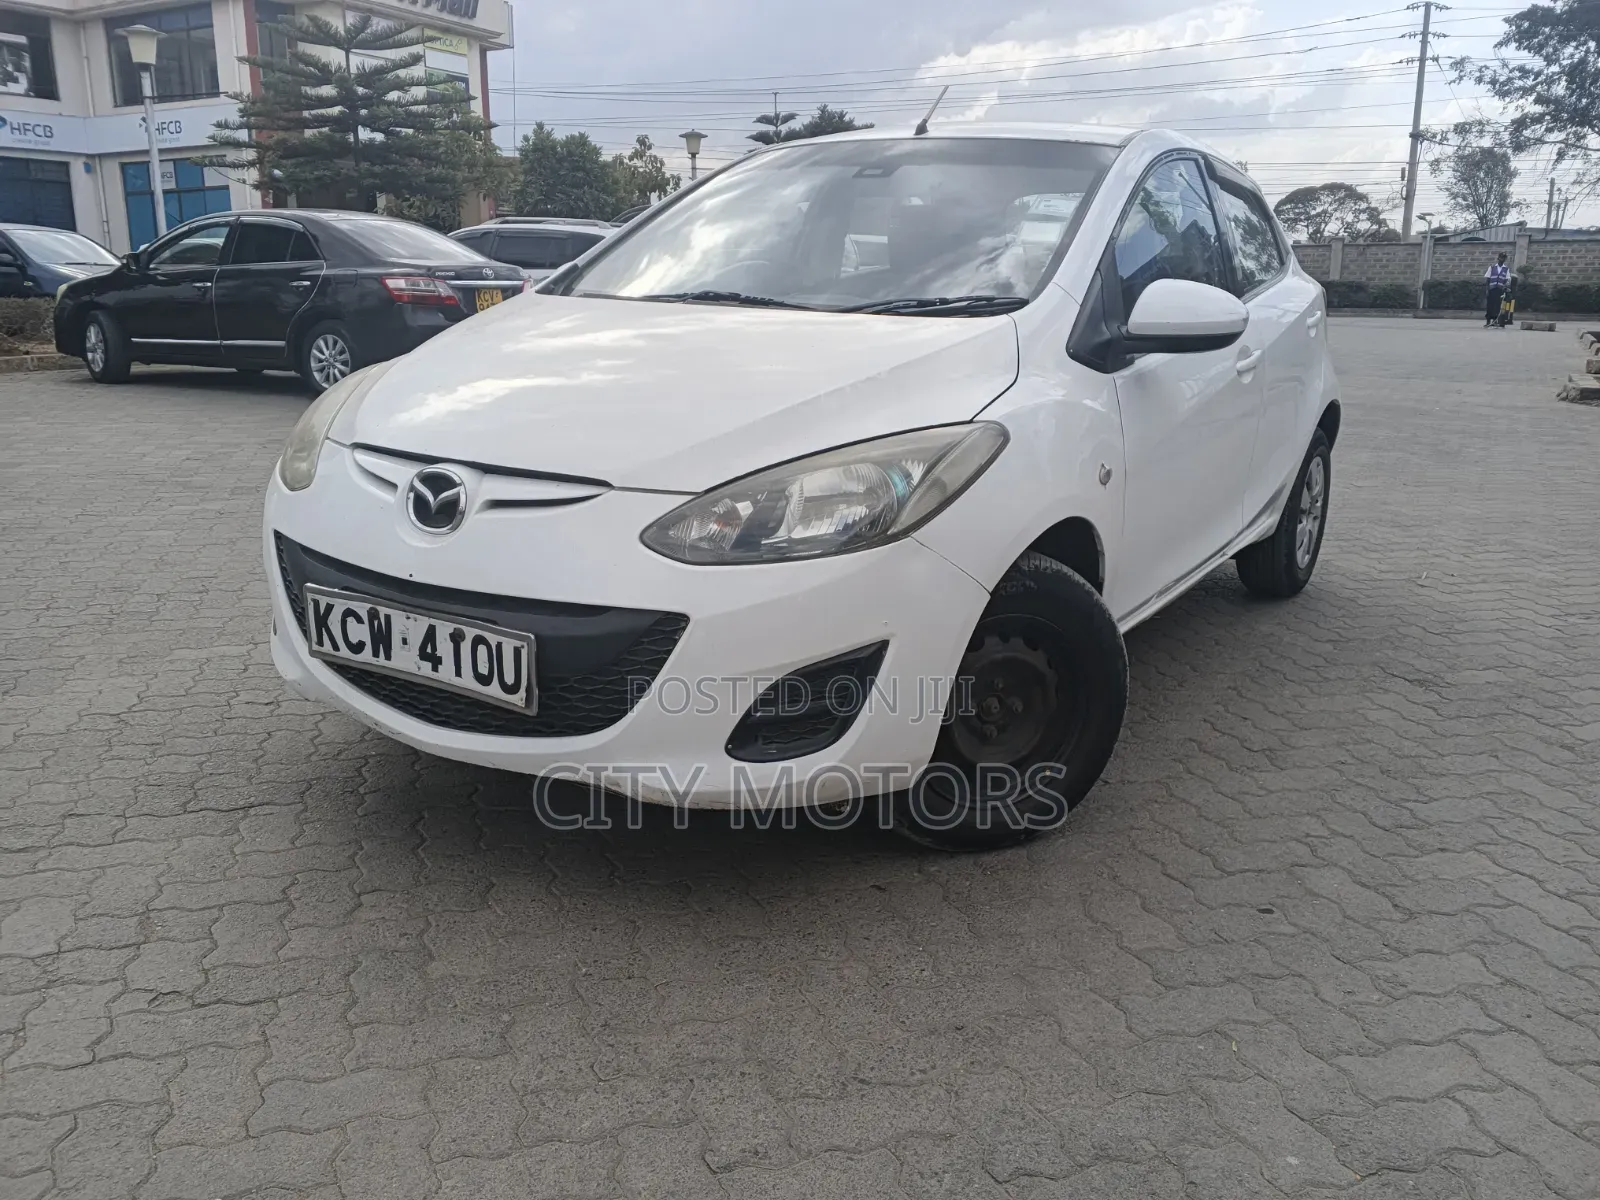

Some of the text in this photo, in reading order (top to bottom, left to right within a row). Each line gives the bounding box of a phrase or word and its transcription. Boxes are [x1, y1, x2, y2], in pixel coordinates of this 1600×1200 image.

[9, 121, 54, 139] HFCB
[477, 289, 495, 303] KCV
[311, 598, 523, 696] KCW 410U
